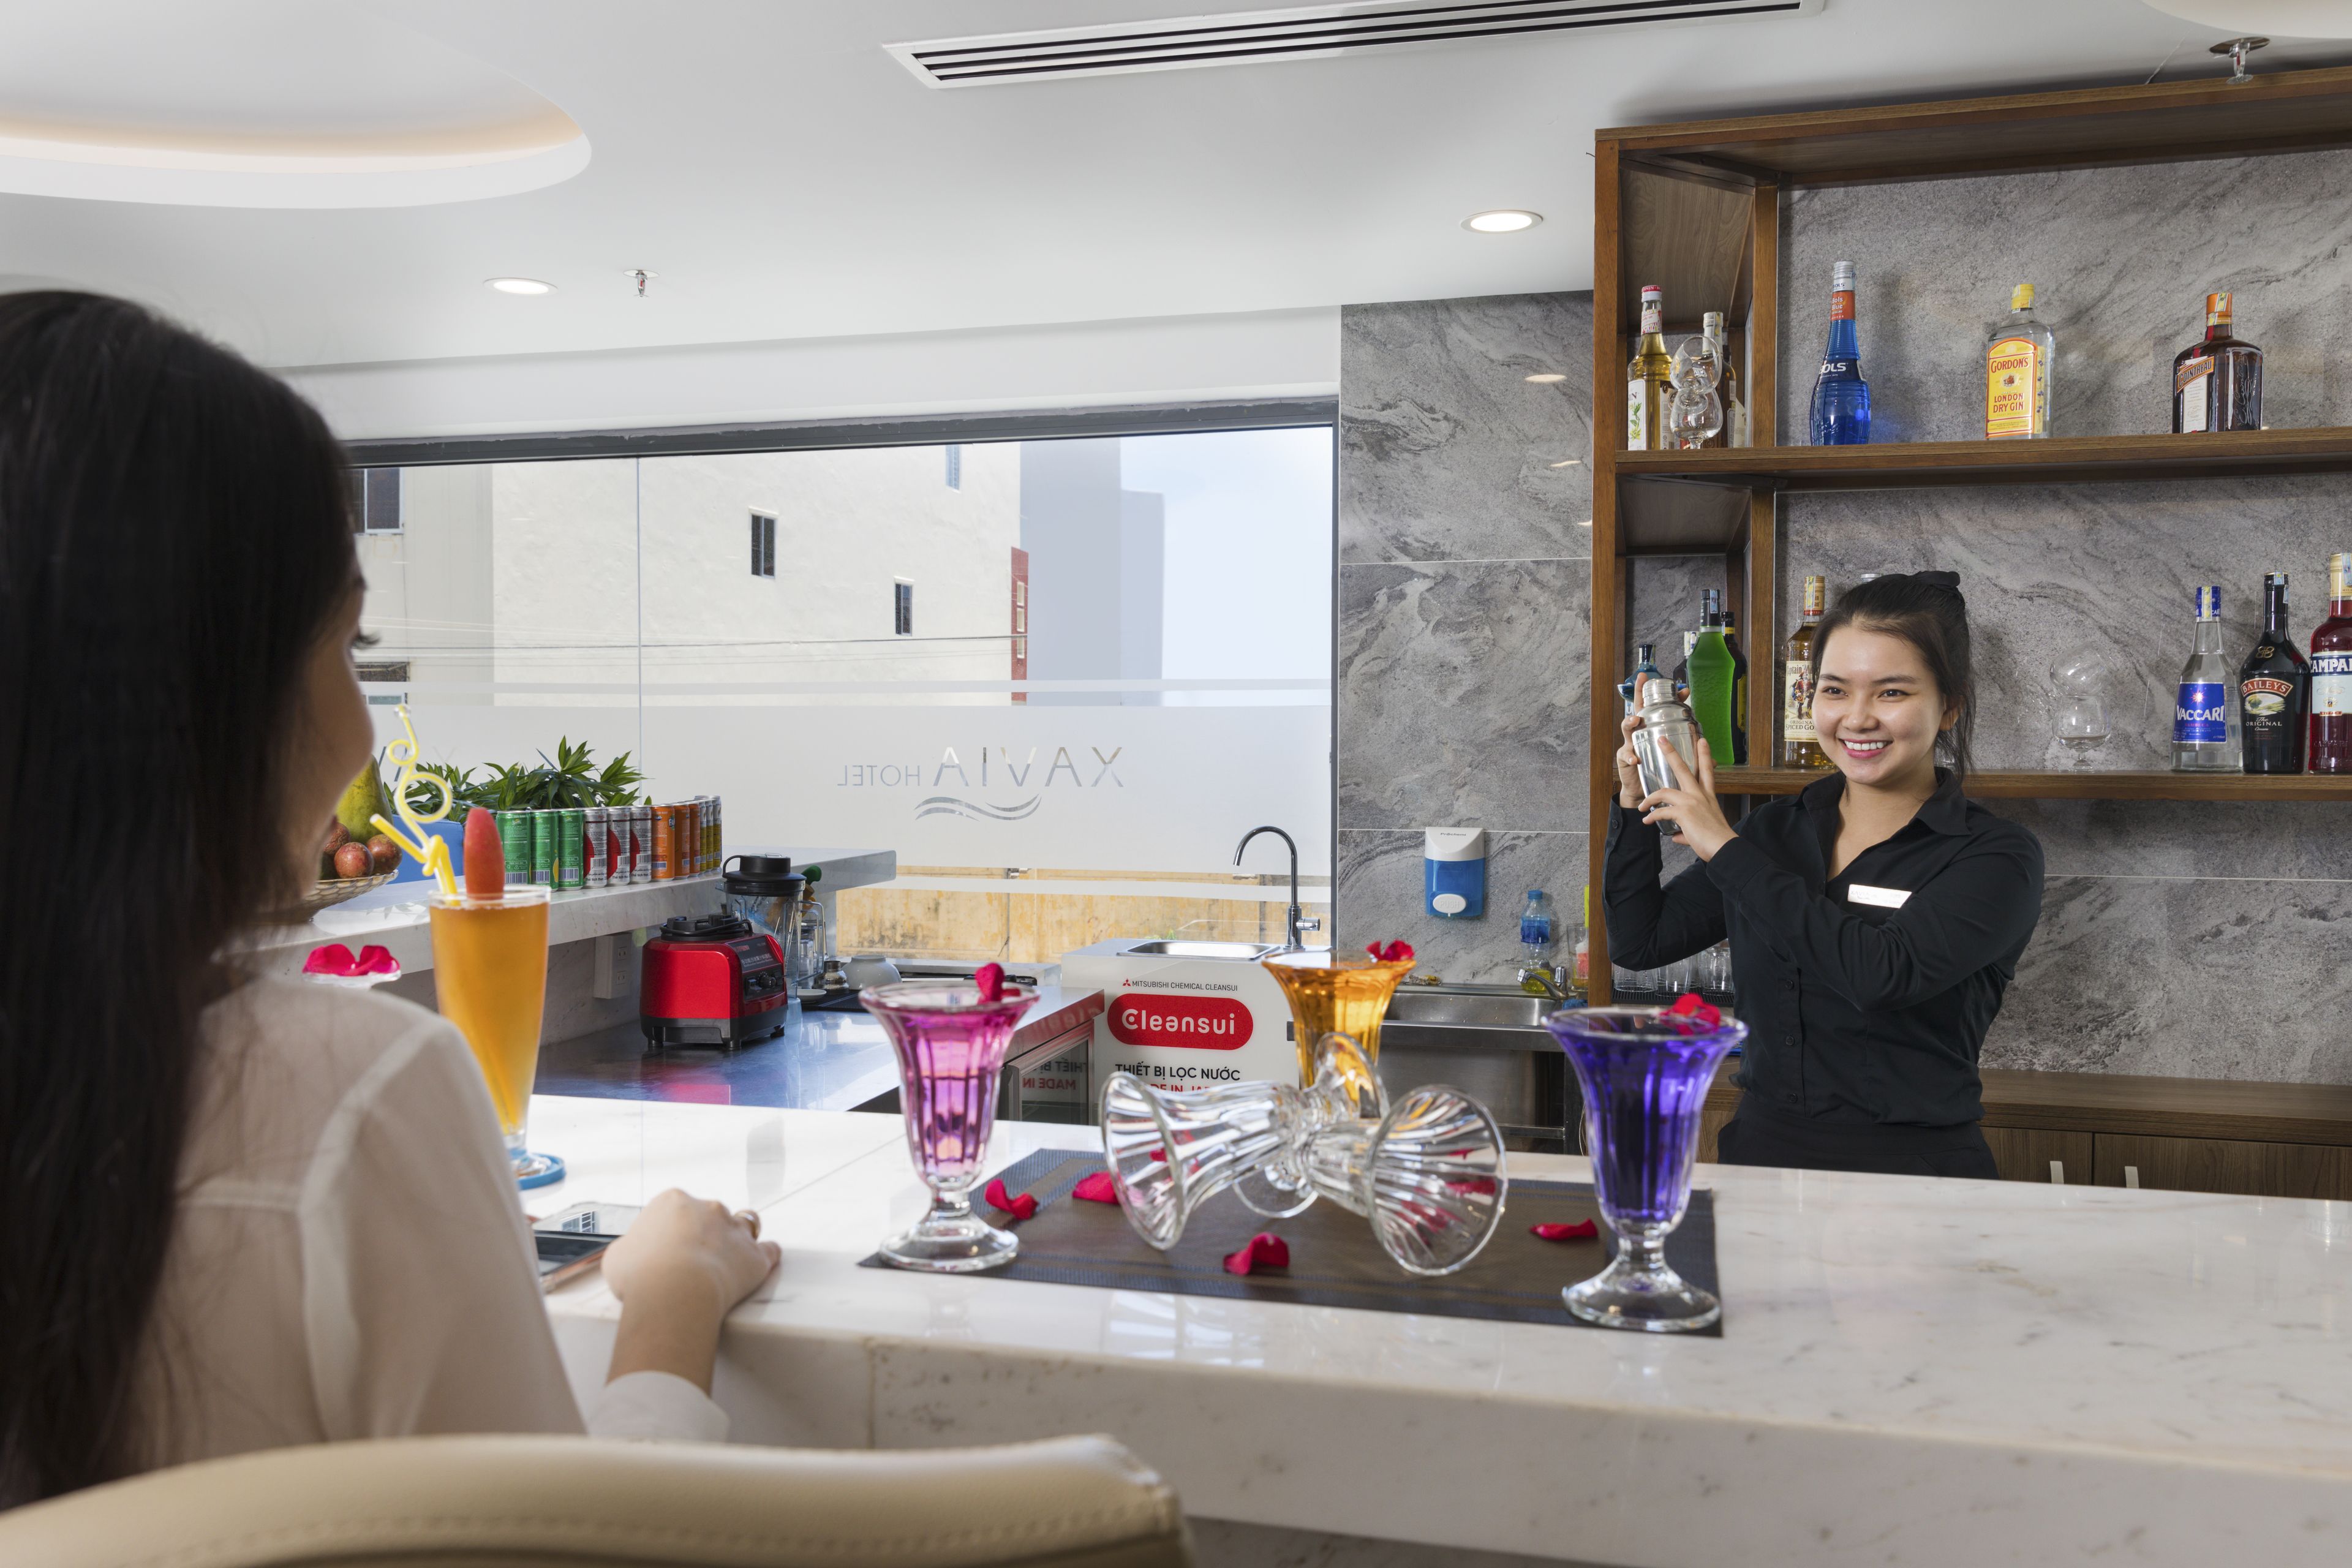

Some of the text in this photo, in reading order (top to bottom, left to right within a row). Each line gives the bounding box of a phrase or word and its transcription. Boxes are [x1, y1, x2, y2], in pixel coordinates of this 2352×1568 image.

[1991, 358, 2029, 373] GORDON'S
[2179, 360, 2212, 388] COINTREAU
[1994, 393, 2023, 403] LONDON
[1993, 401, 2024, 413] DRY GIN
[2242, 681, 2286, 693] BAILEYS
[2177, 704, 2225, 722] VACCARI
[1121, 1009, 1235, 1035] Cleansui
[1154, 1066, 1166, 1080] BỊ
[1170, 1066, 1197, 1080] LỌC
[1201, 1066, 1240, 1081] NƯỚC
